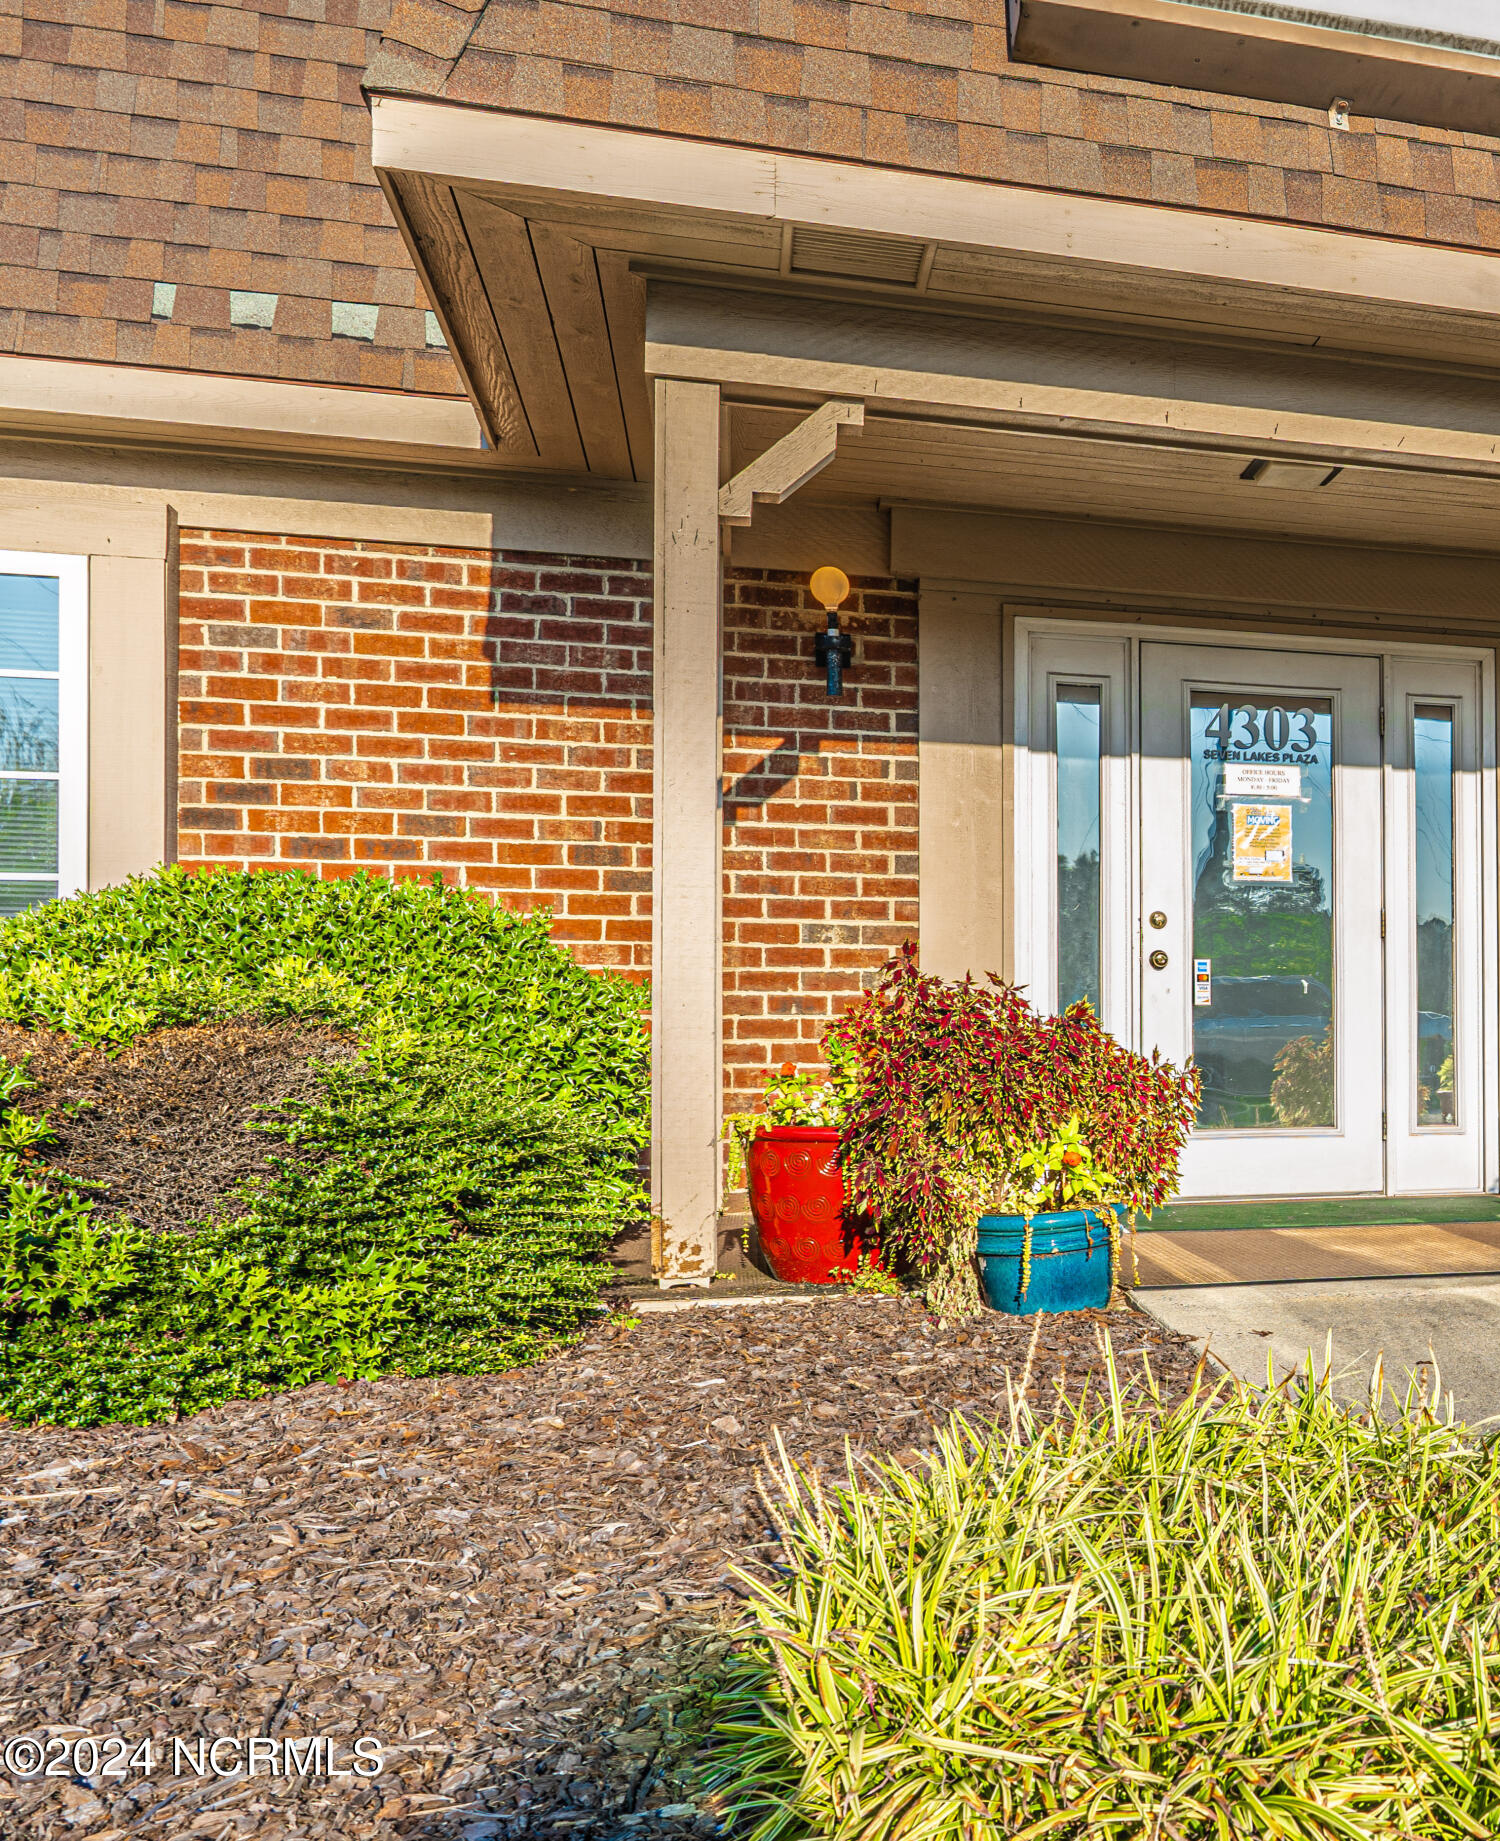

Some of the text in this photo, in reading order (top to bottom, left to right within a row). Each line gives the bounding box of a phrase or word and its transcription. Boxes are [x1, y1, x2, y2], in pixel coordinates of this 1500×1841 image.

[1204, 703, 1317, 752] 4303
[1203, 749, 1319, 764] SEVEN LAKES PLAZA
[1247, 815, 1279, 825] MOVING
